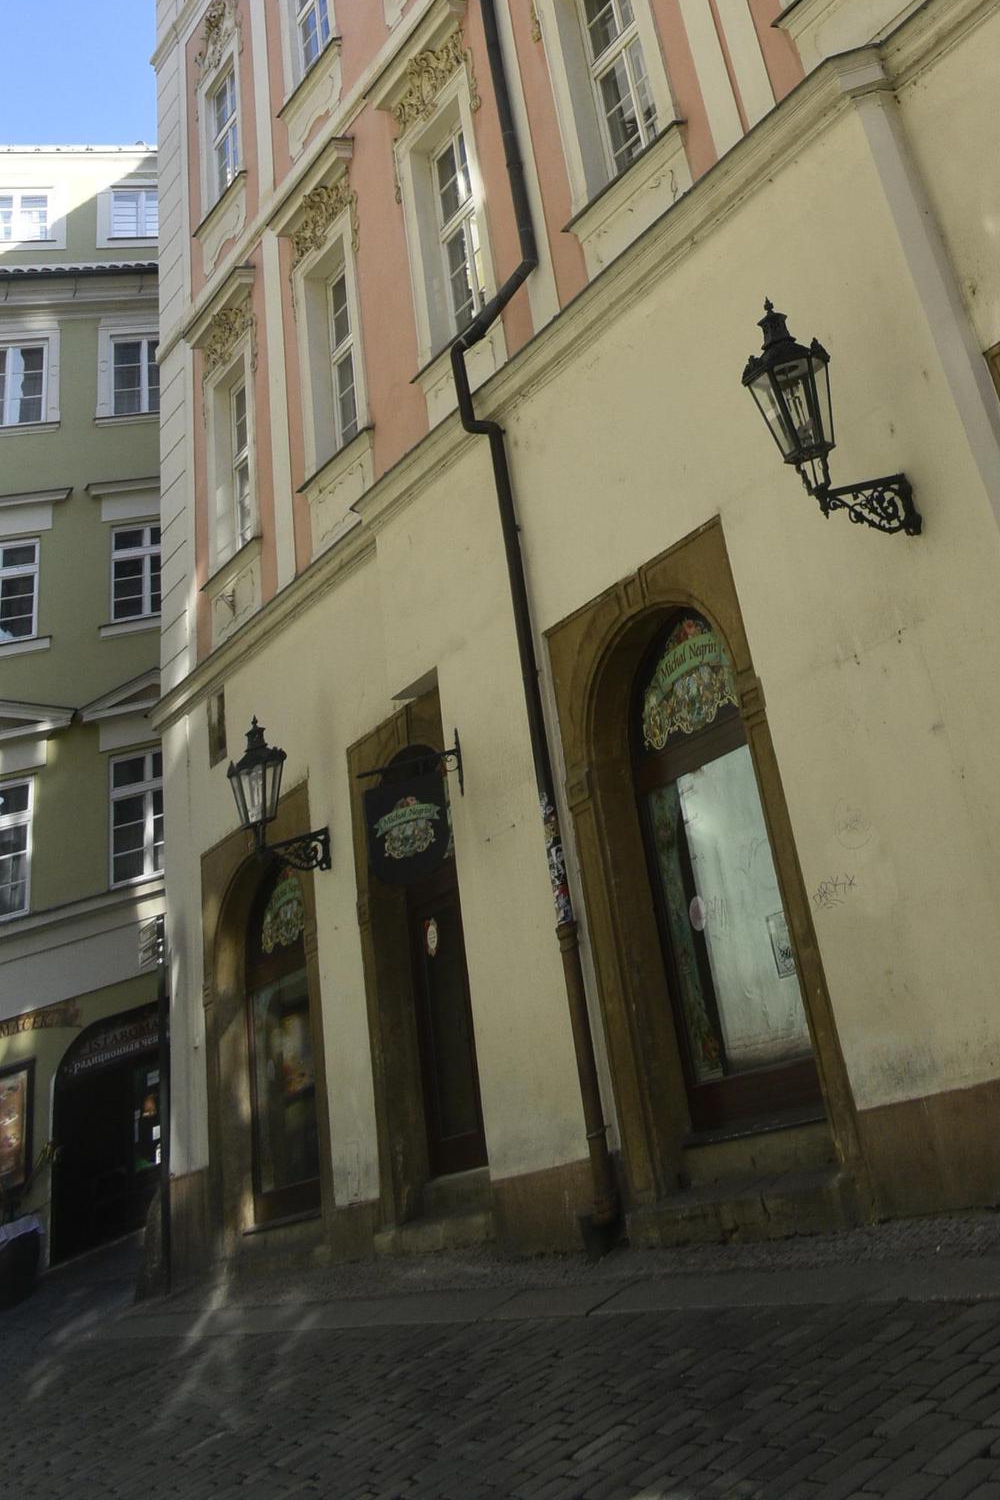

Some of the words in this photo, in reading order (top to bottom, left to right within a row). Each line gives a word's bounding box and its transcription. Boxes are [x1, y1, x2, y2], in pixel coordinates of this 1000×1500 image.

[659, 644, 687, 682] Michal
[688, 638, 717, 662] Negrin
[383, 809, 407, 827] Michal
